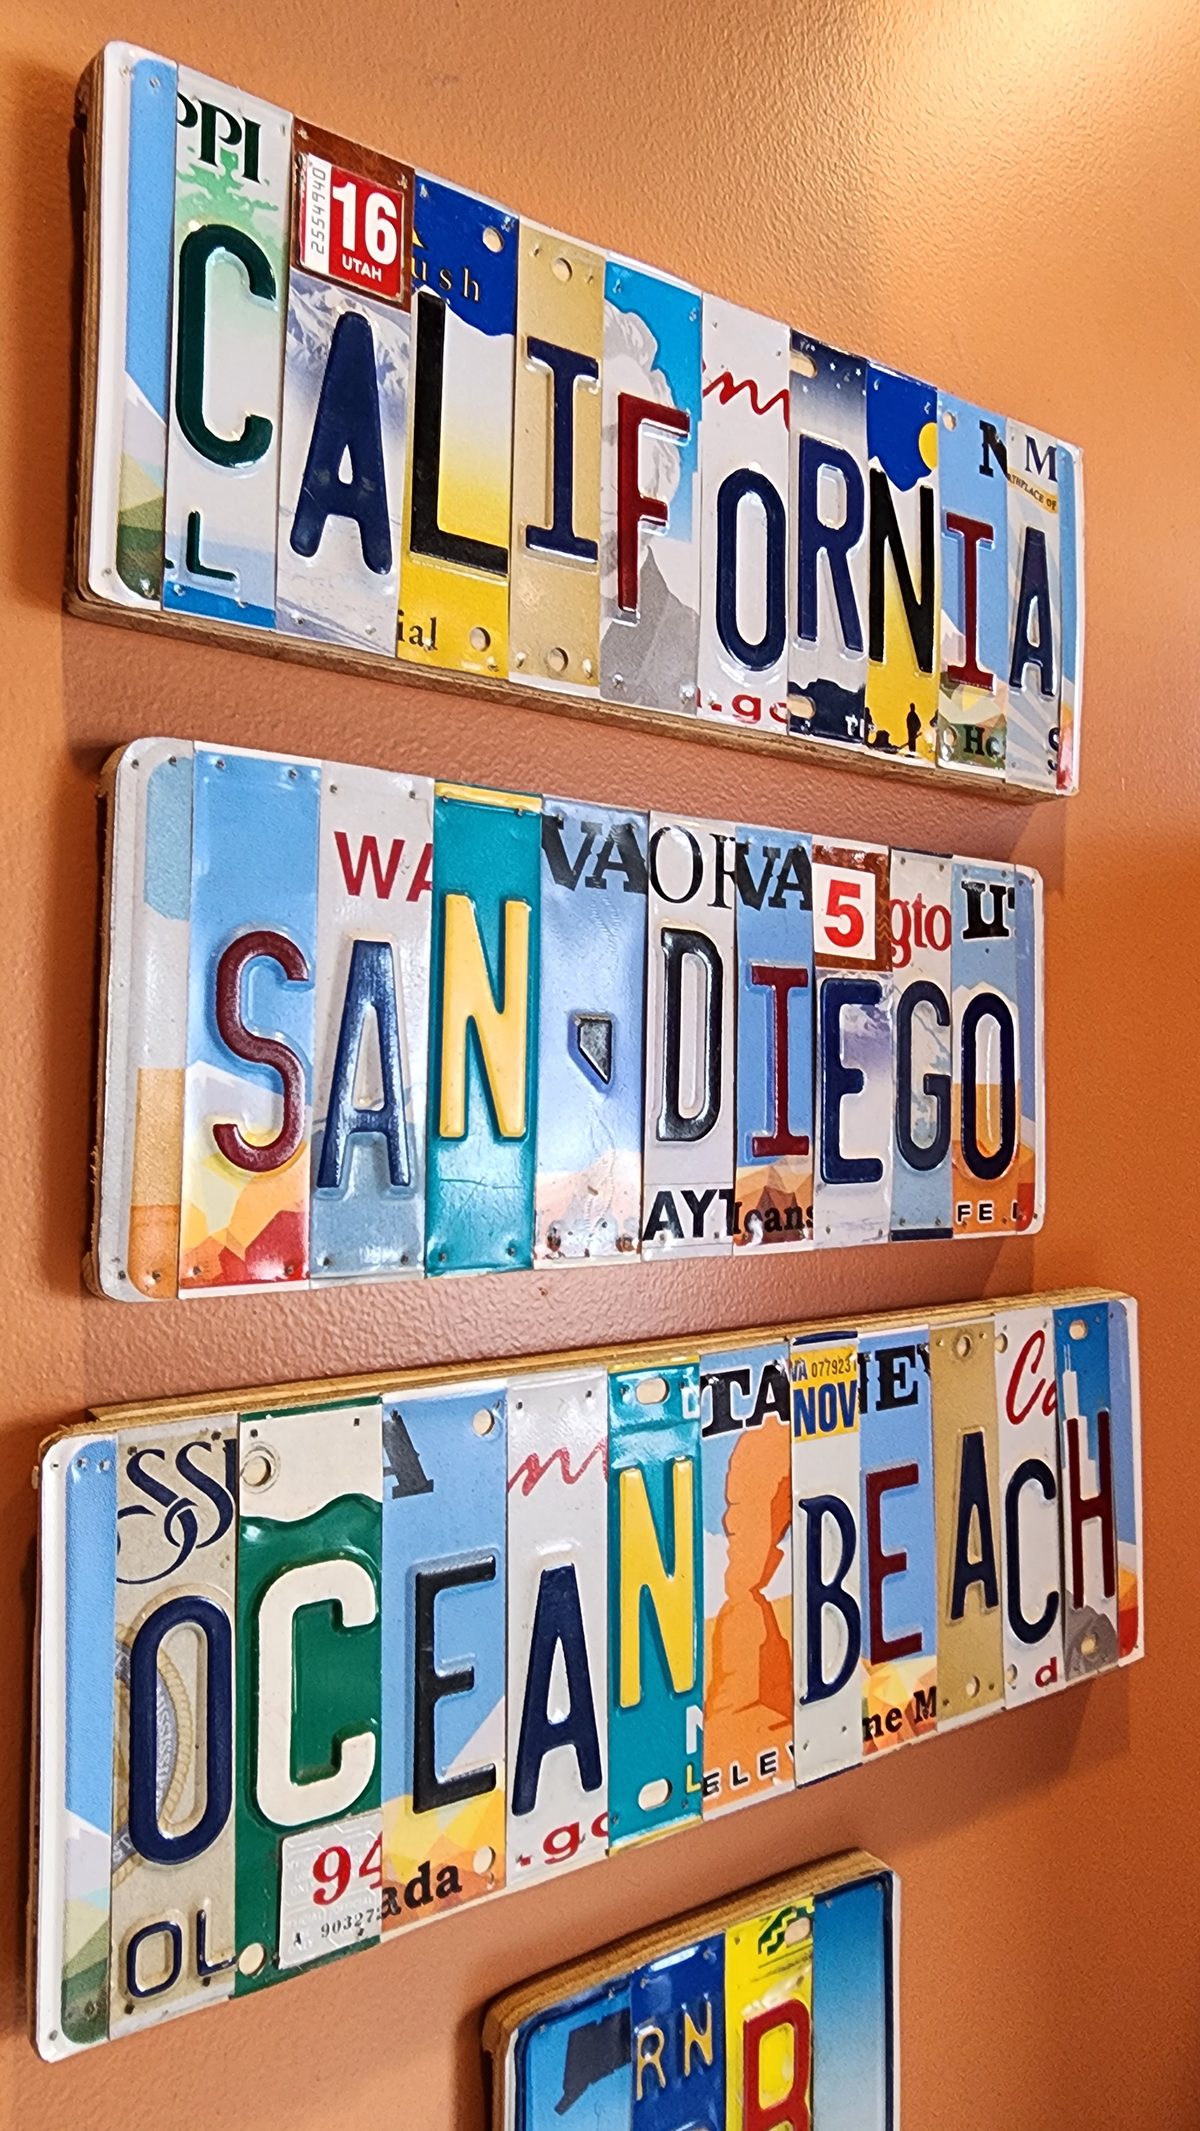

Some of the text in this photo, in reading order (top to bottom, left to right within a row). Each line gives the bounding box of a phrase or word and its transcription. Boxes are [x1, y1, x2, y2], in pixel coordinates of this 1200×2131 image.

[332, 181, 398, 265] 16
[341, 254, 382, 282] UTAH
[175, 223, 1055, 696] CALIFORNIA
[1025, 434, 1058, 483] M
[165, 510, 238, 581] L
[397, 609, 438, 651] ial
[541, 814, 649, 894] VA
[824, 879, 864, 947] 5
[889, 893, 952, 968] gto
[961, 880, 1015, 939] U
[213, 894, 1015, 1188] SAN DIEGO
[700, 1364, 790, 1438] TA
[793, 1380, 857, 1437] NOV
[128, 1410, 1115, 1864] OCEAN BEACH
[702, 1745, 794, 1796] ELE
[381, 1860, 463, 1920] ada
[126, 1908, 239, 1998] OL
